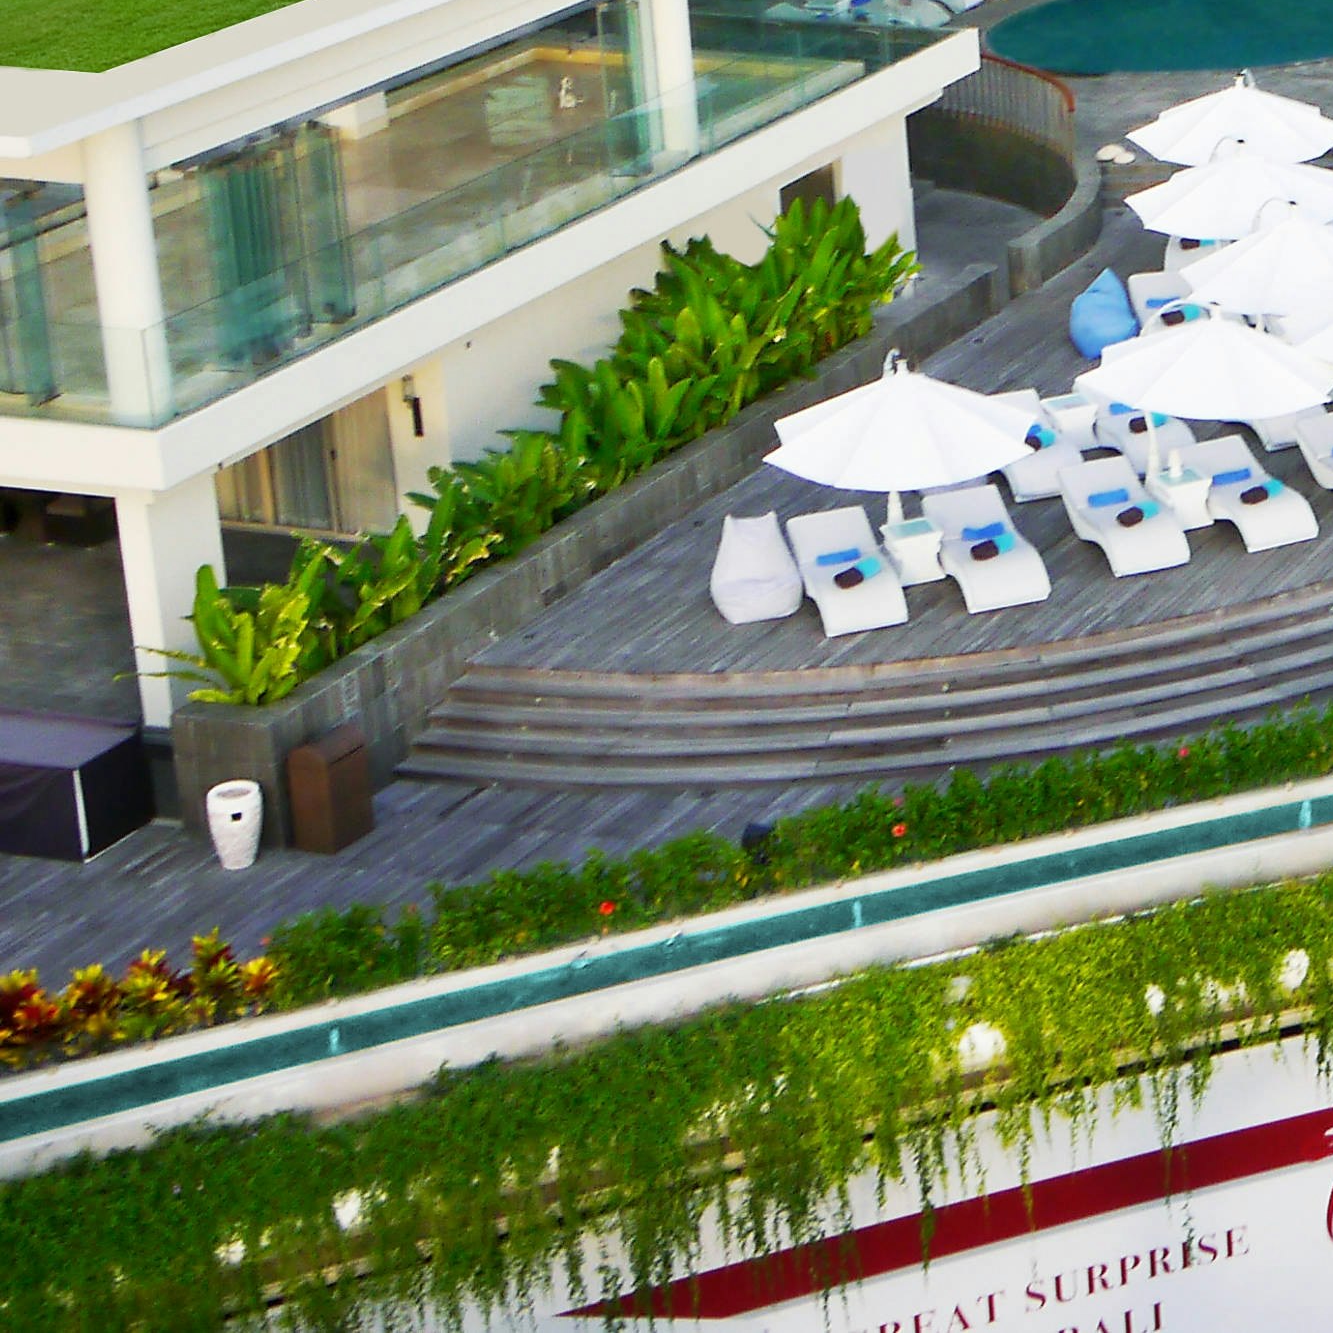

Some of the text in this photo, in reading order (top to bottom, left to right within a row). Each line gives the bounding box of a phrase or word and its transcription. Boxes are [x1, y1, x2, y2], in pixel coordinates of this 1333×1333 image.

[851, 1225, 1250, 1333] EAT SURPRISE
[1056, 1302, 1163, 1333] ALI
